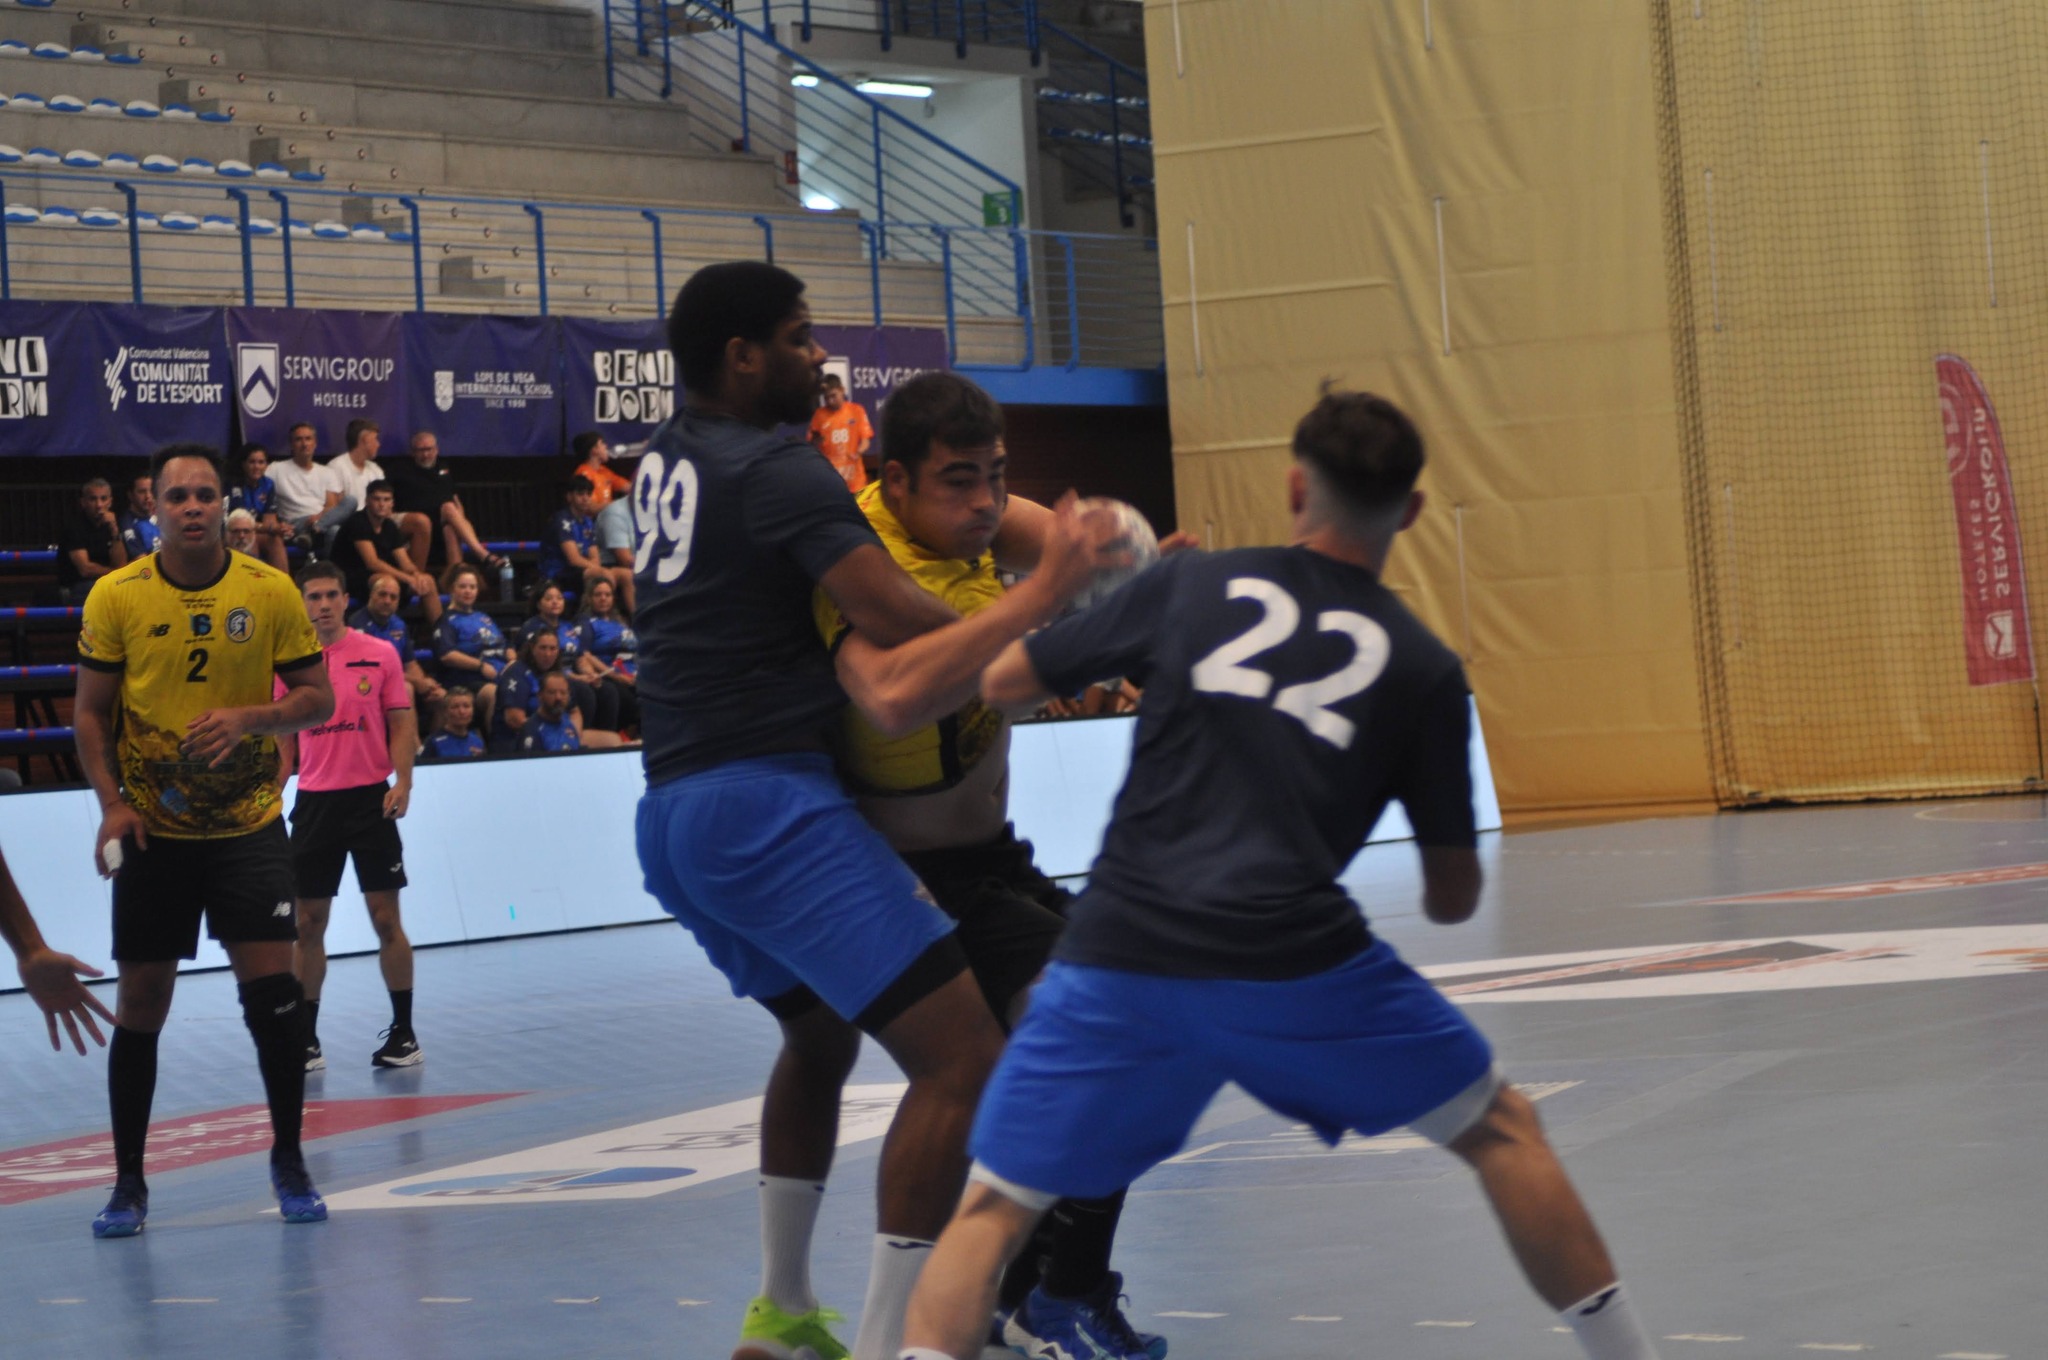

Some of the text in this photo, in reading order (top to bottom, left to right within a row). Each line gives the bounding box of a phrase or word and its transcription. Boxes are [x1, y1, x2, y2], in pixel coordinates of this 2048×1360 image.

[128, 346, 172, 359] Comunitat
[130, 362, 210, 382] COMUNITAT
[283, 356, 394, 381] SERVIGROUP
[474, 372, 536, 383] LOPE DE VEGA
[594, 349, 674, 386] BENI
[136, 383, 223, 403] DE L'ESPORT
[455, 383, 554, 395] INTERNATIONAL SCHOOL
[313, 393, 367, 408] HOTELES
[634, 451, 699, 583] 99
[187, 648, 208, 682] 2
[1190, 576, 1391, 750] 22
